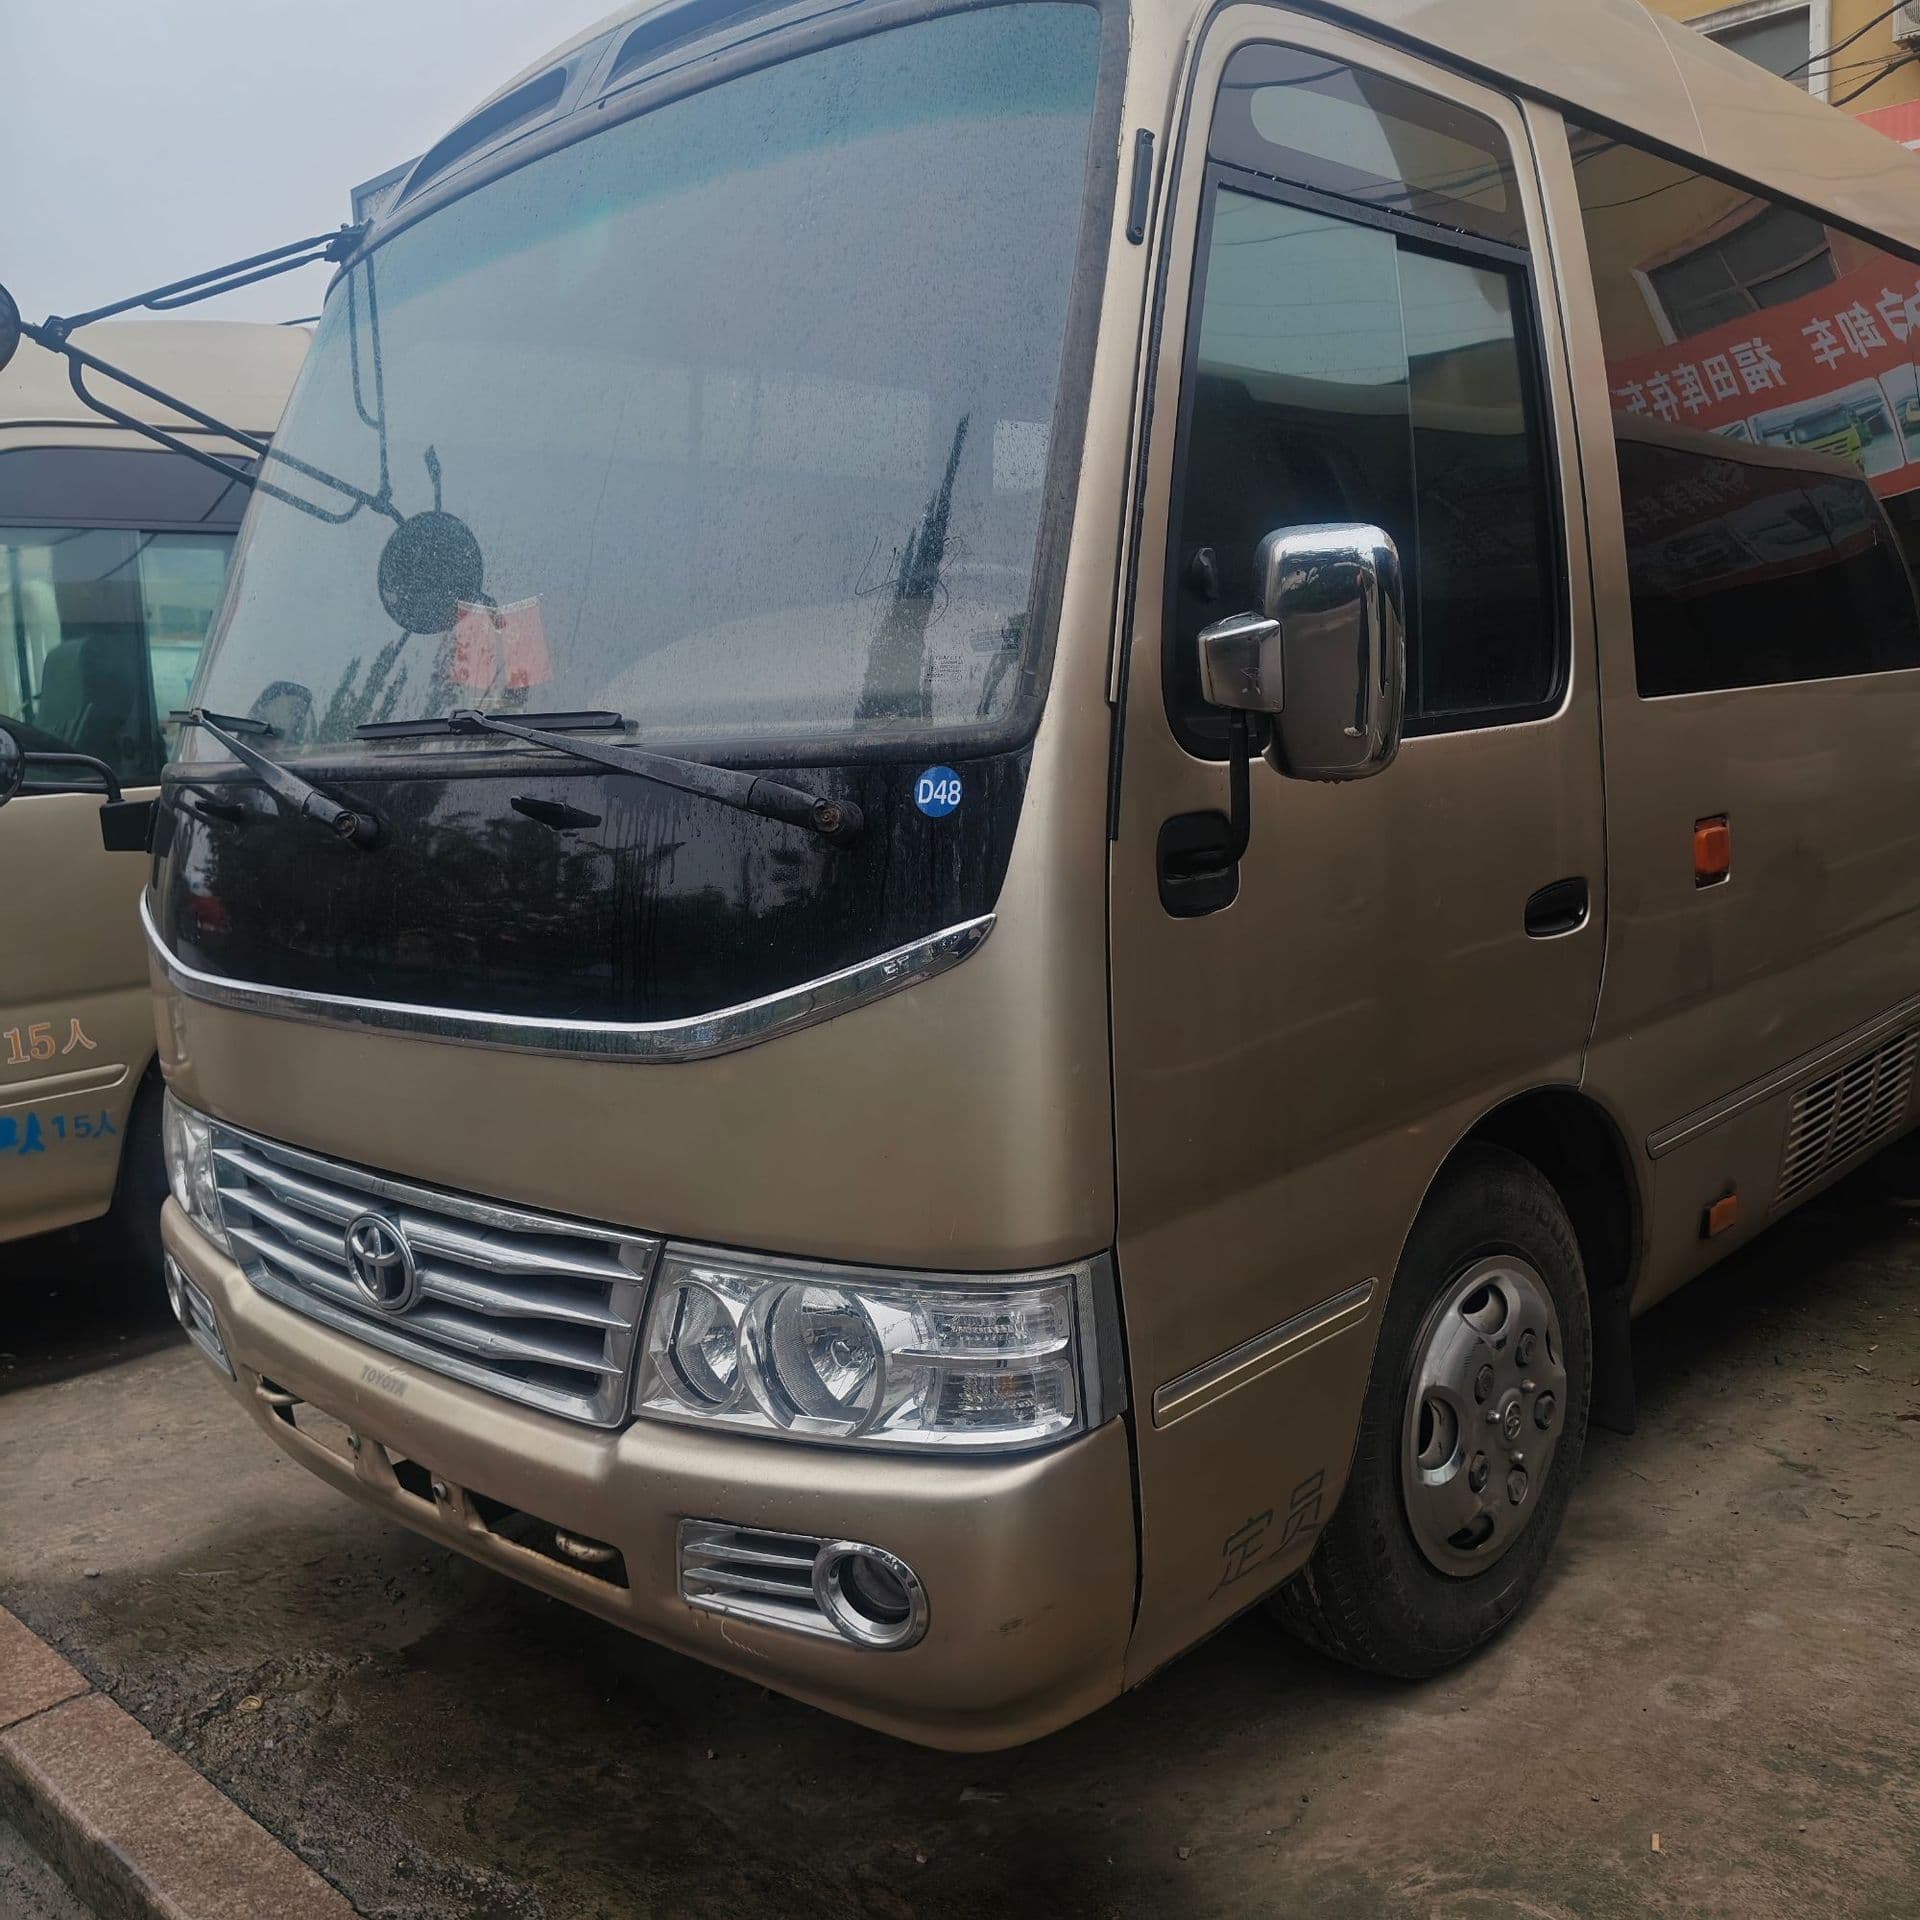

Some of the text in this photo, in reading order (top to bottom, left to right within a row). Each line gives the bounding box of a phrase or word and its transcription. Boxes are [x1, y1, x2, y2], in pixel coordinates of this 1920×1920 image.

[918, 778, 961, 806] D48
[3, 1017, 98, 1065] 15人
[362, 1364, 409, 1397] TOYOTA
